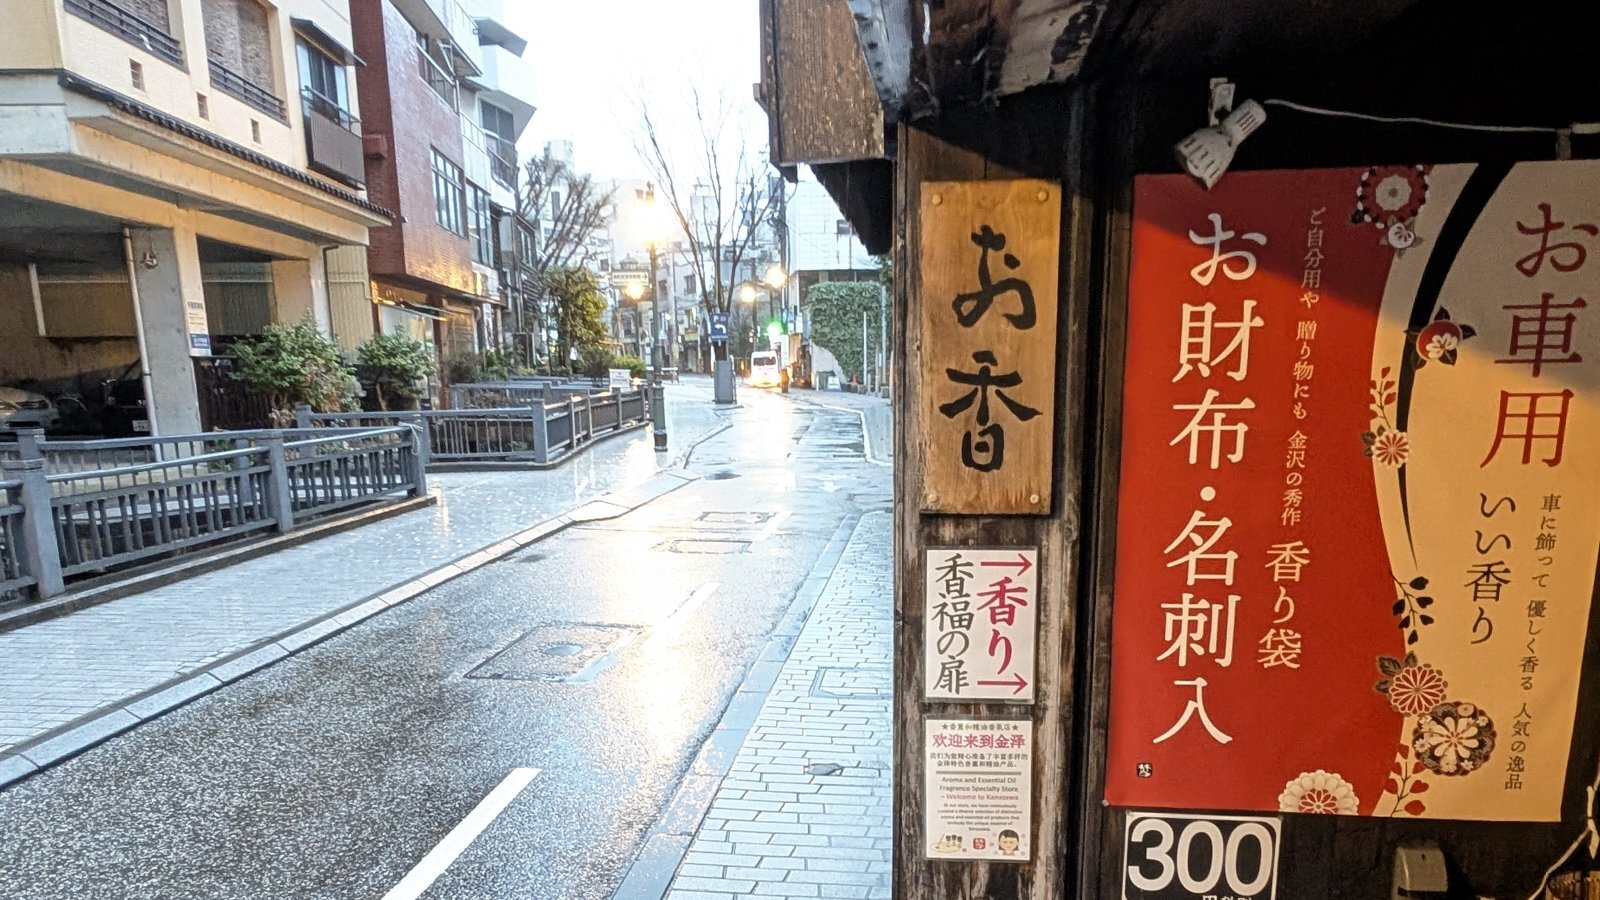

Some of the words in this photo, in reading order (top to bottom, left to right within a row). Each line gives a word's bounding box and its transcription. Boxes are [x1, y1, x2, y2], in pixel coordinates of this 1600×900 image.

[939, 225, 1043, 473] お香
[1293, 320, 1317, 420] 贈り物にも
[1480, 203, 1599, 469] お車用
[1153, 212, 1268, 744] お財布・名刺入
[1281, 430, 1308, 527] 金沢の秀作
[1464, 493, 1516, 645] いい香り
[1532, 493, 1561, 588] 車に飾って
[931, 553, 974, 695] 香福の扉
[976, 576, 1028, 675] 香り
[1257, 540, 1310, 669] 香り袋
[1518, 599, 1547, 691] 優しく香る
[932, 733, 1026, 749] 欢迎来到金泽
[971, 785, 1000, 793] Specialty
[1001, 785, 1019, 793] Store
[1504, 702, 1532, 790] 人気の逸品
[1127, 818, 1273, 897] 300
